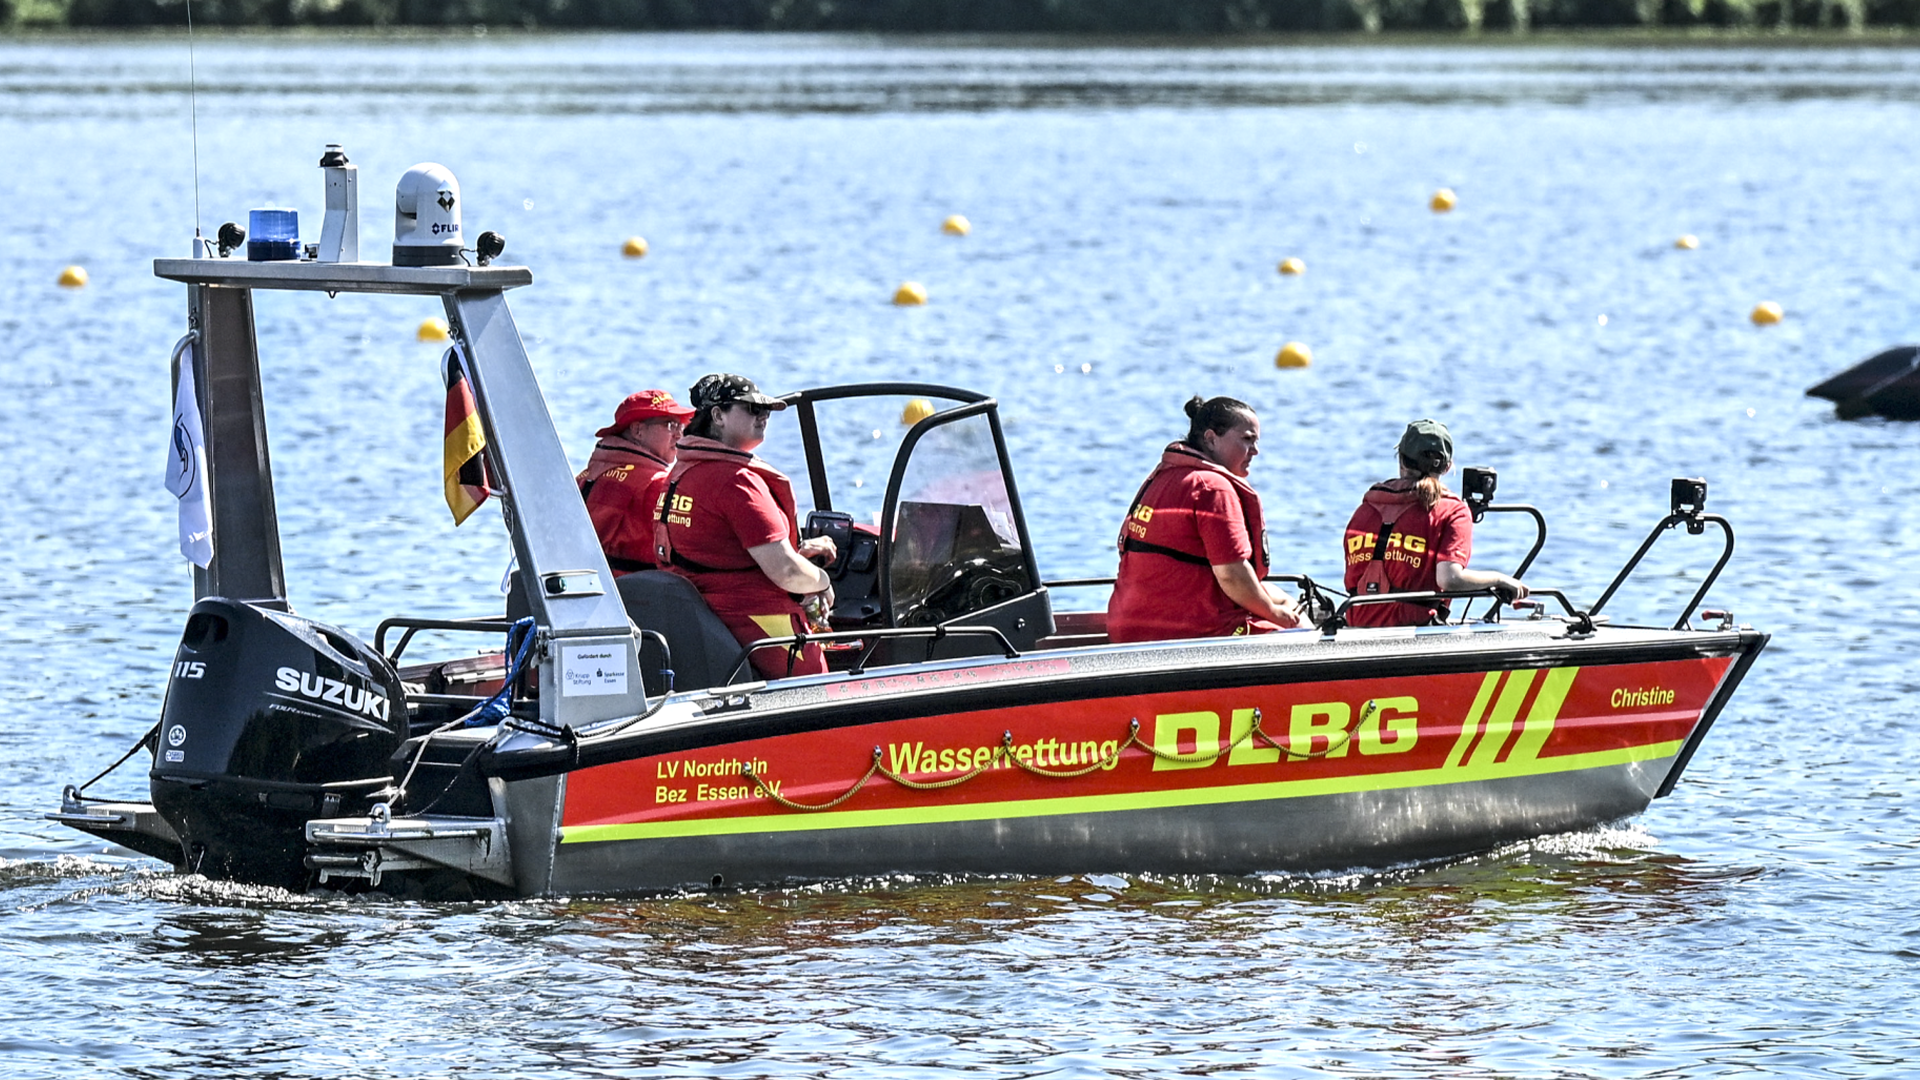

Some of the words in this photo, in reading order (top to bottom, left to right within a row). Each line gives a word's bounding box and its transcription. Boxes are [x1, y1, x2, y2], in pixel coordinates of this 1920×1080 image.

[441, 224, 459, 233] FLIR
[657, 492, 694, 512] LRG
[175, 661, 207, 679] 115
[275, 666, 390, 722] SUZUKI
[1610, 685, 1675, 708] Christine
[1152, 696, 1418, 772] DLRG
[657, 760, 679, 779] LV
[683, 756, 768, 778] Nordrhin
[889, 737, 1118, 775] Wasserrettung
[655, 785, 688, 804] Bez
[697, 783, 749, 802] Essen
